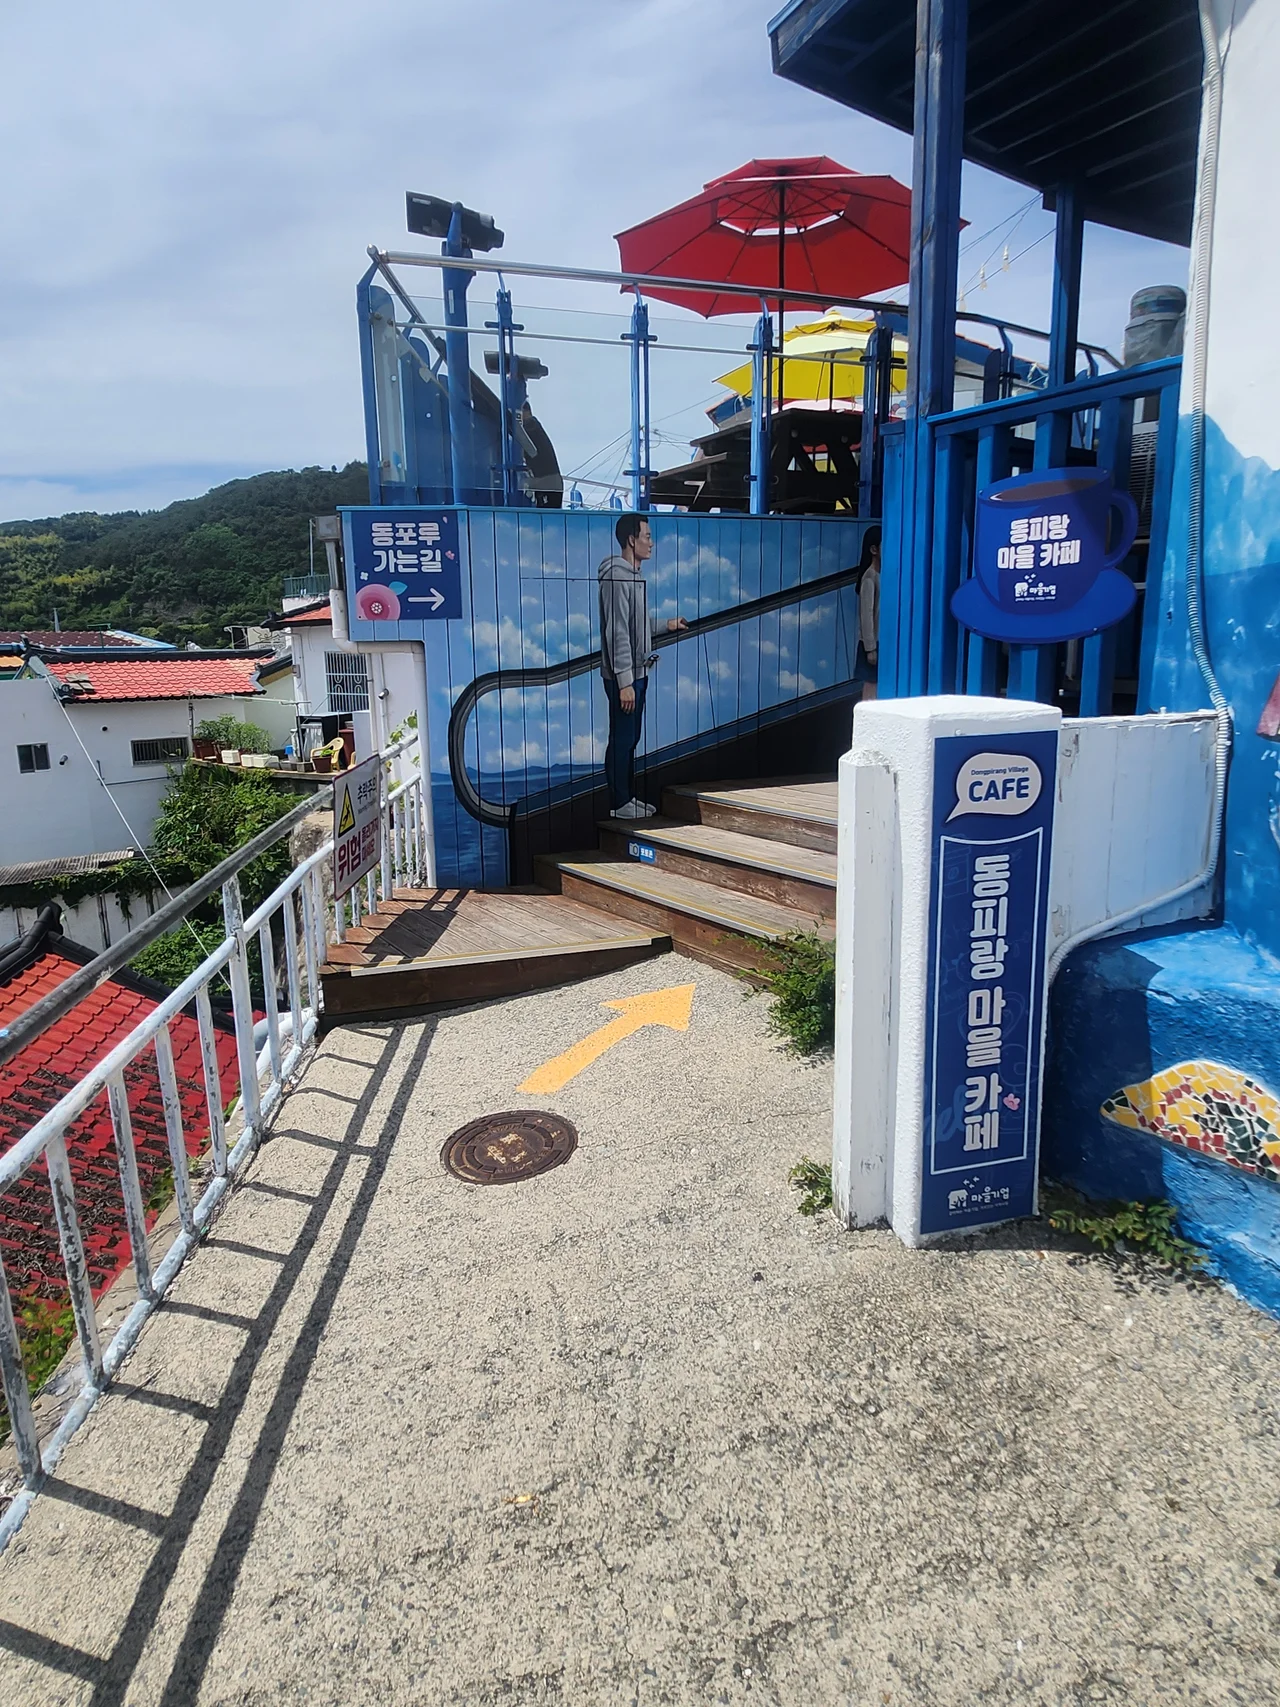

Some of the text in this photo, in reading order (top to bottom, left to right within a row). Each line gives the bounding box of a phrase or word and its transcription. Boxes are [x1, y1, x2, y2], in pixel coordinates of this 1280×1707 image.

[371, 522, 441, 546] 동포루
[1010, 514, 1070, 544] 동피랑
[373, 549, 442, 573] 가는길
[997, 539, 1081, 569] 마을 카페
[1029, 582, 1056, 596] 마을기업
[970, 767, 1007, 776] Dongpirang
[968, 776, 1030, 802] CAFE
[338, 831, 361, 882] 위험
[963, 854, 1010, 1151] 동피랑 마을 카페
[971, 1186, 1009, 1203] 마을기업
